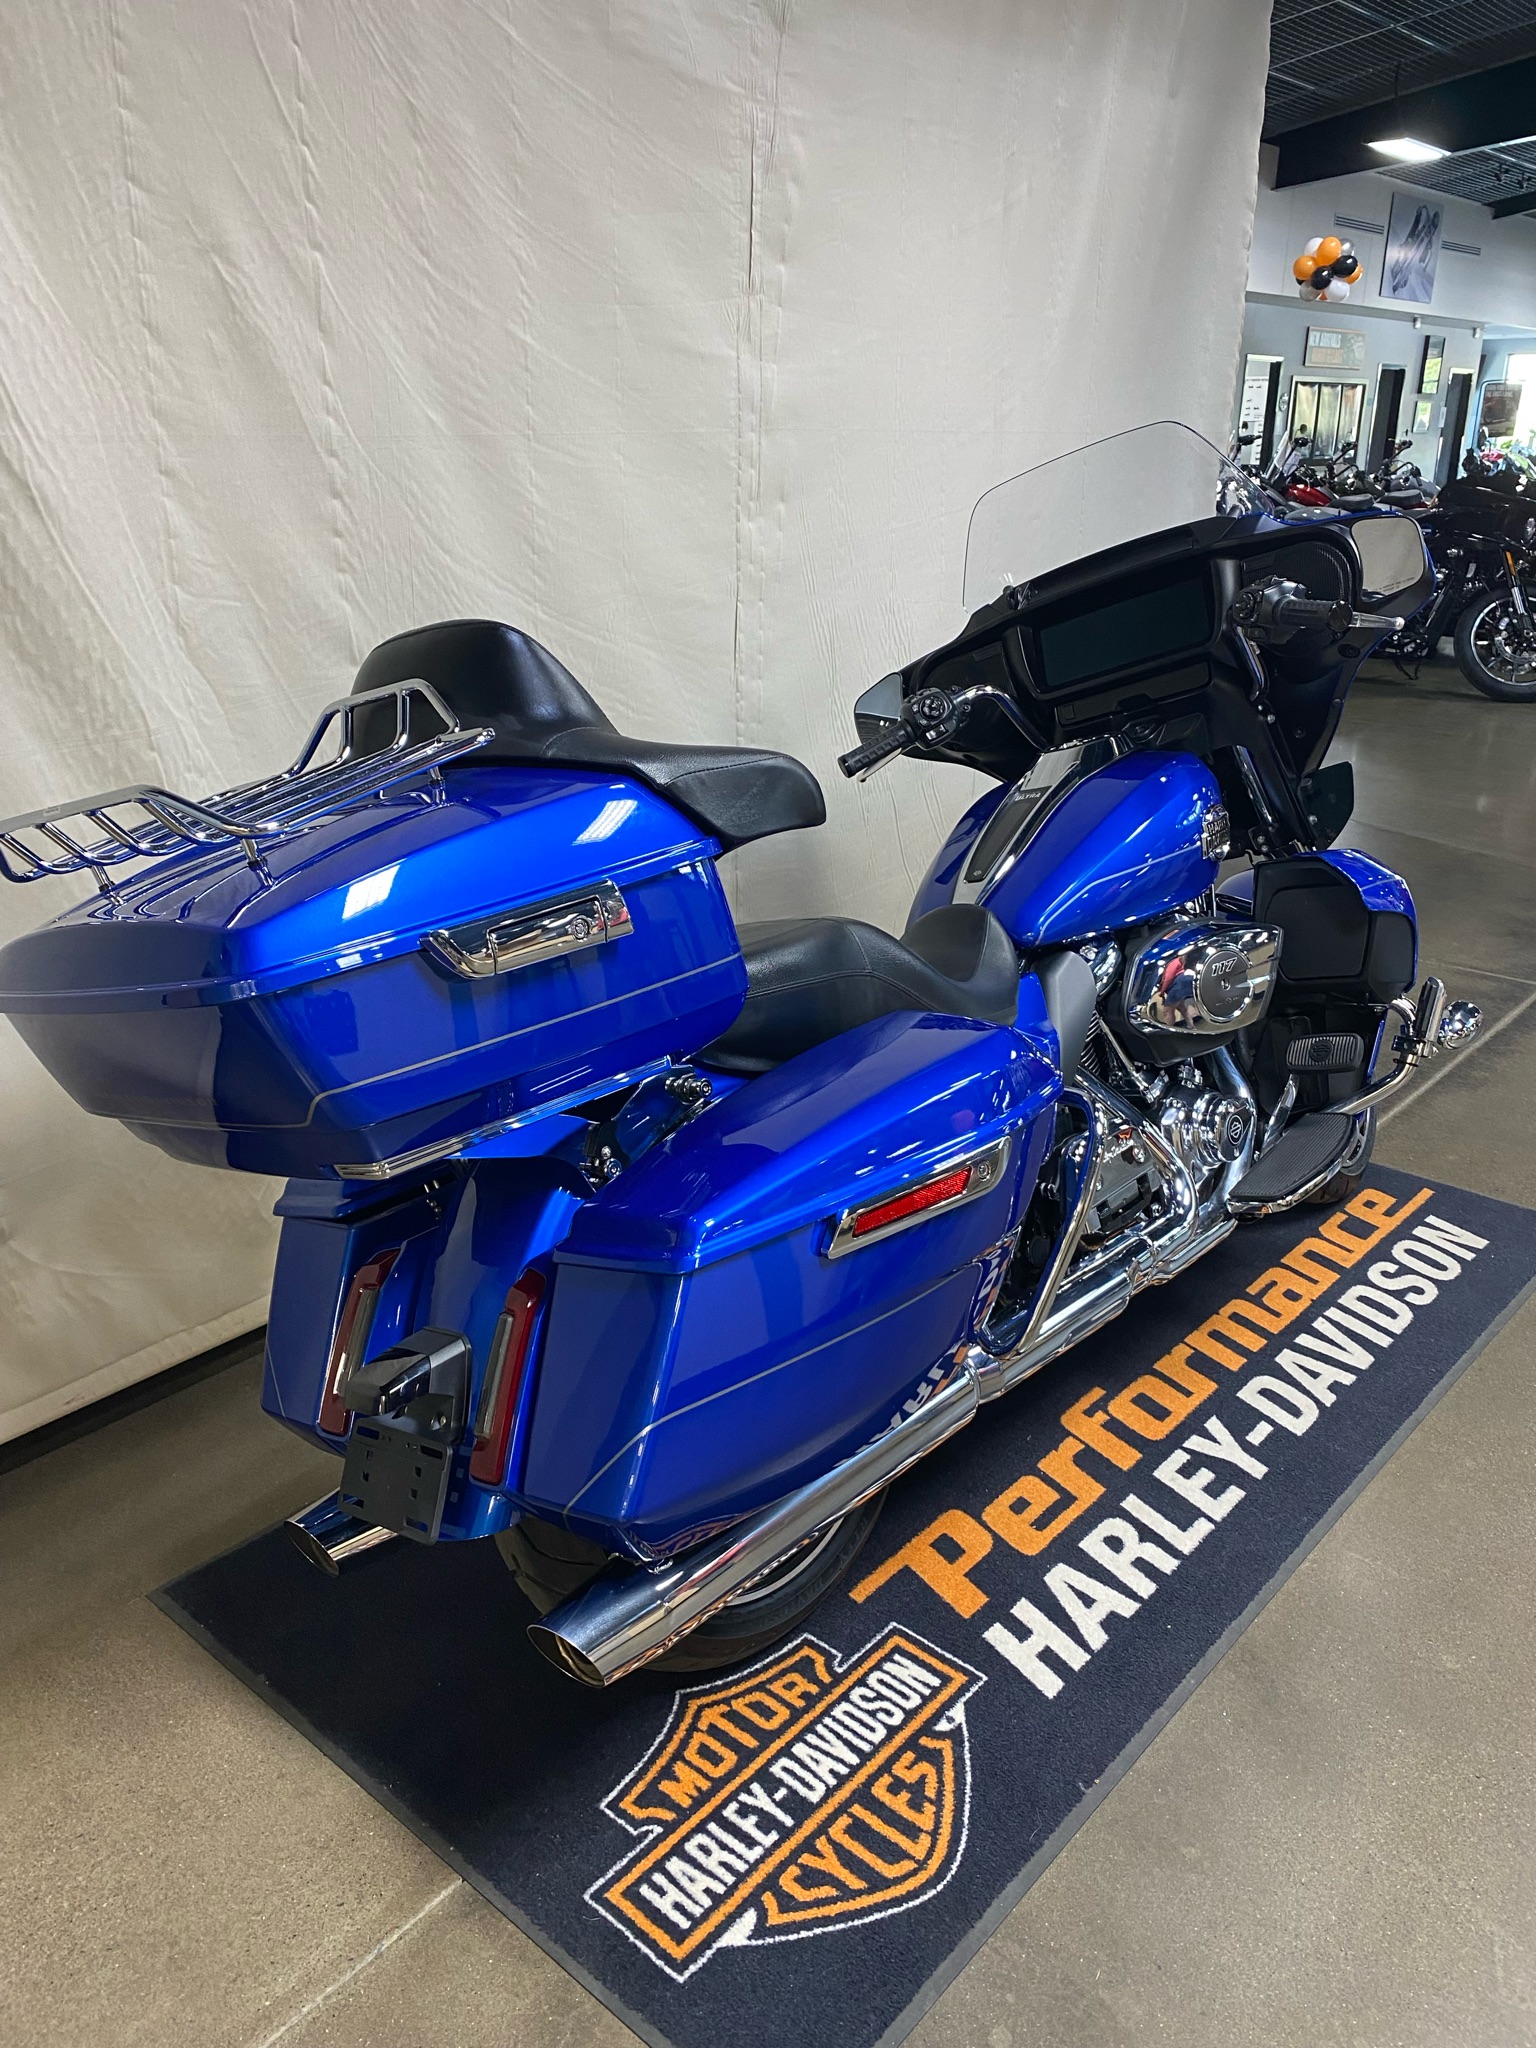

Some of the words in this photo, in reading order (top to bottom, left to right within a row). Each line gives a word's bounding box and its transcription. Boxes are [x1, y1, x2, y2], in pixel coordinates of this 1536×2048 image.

[1212, 957, 1238, 976] 117
[848, 1187, 1434, 1619] Performance
[982, 1214, 1490, 1699] HARLEY-DAVIDSON
[639, 1653, 942, 1930] HARLEY-DAVIDSON
[657, 1672, 820, 1807] MOTOR
[778, 1750, 939, 1902] CYCLES
